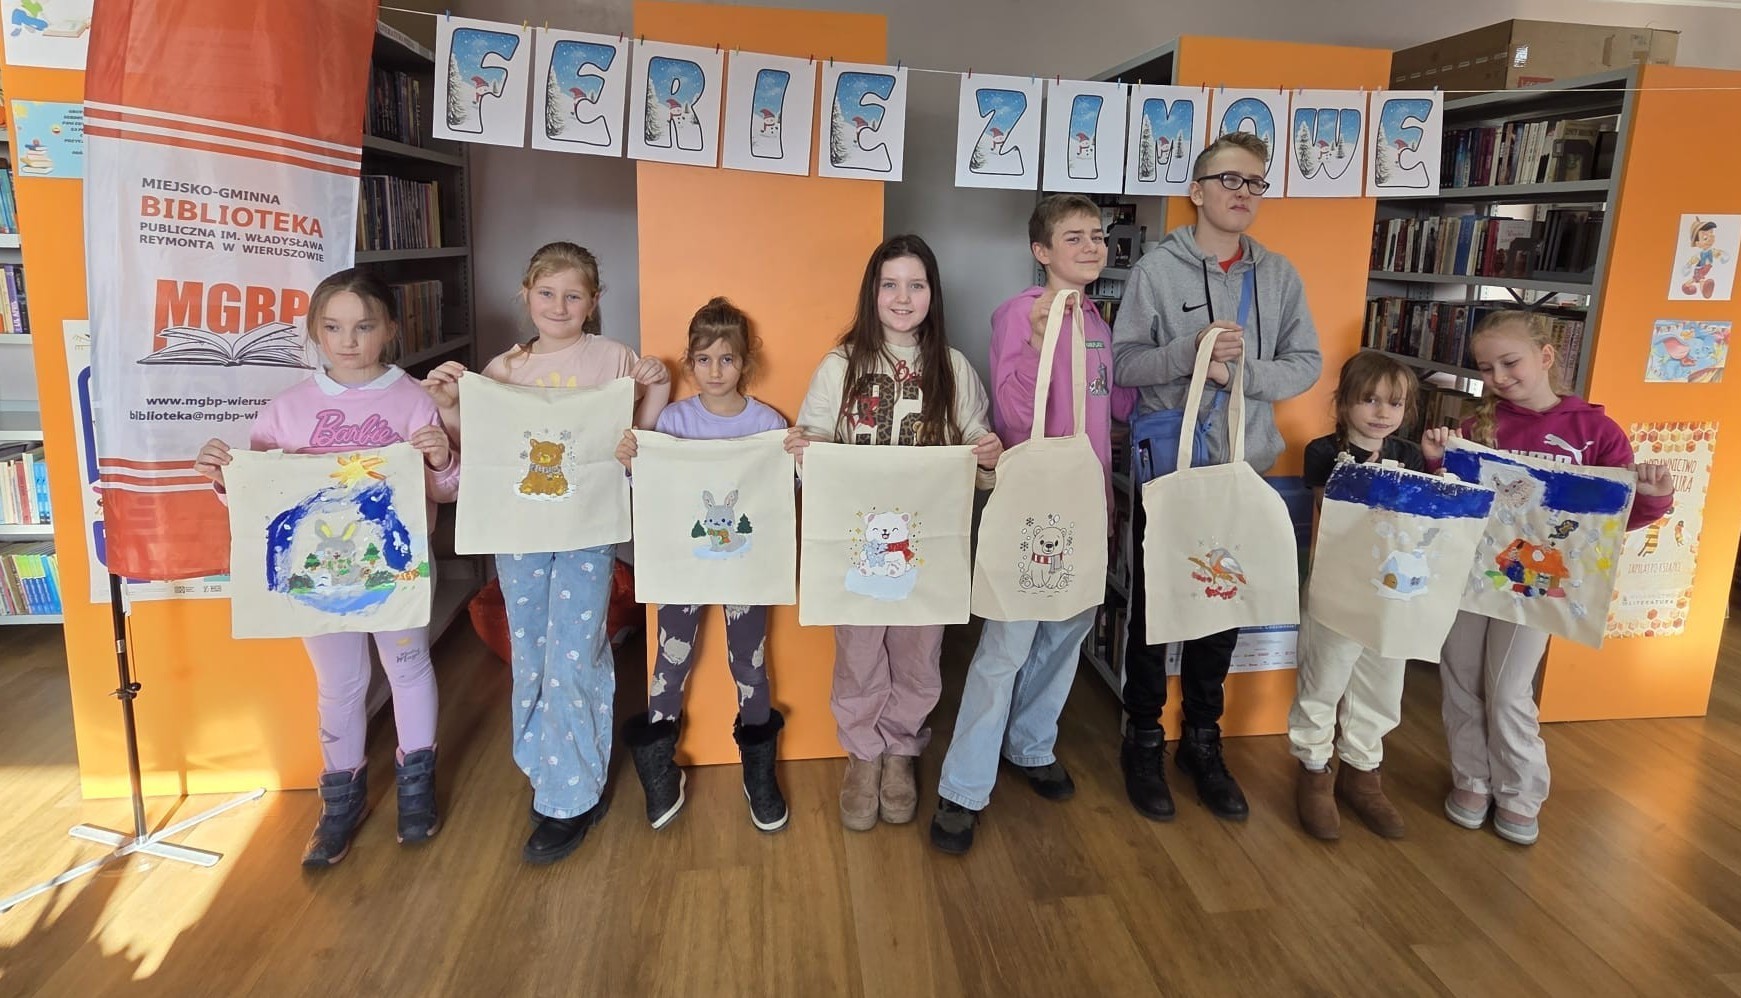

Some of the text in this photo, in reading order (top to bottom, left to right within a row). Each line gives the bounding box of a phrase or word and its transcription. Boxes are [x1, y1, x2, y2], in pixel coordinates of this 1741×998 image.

[446, 27, 1434, 188] FERIE ZIMOWE
[142, 177, 281, 205] MIEJSKO-GMINNA
[140, 195, 324, 238] BIBLIOTEKA
[139, 234, 325, 263] REYMONTA W WIERUSZOWIE
[140, 222, 324, 252] PUBLICZNA IM. WŁADYSŁAWA
[153, 279, 309, 352] MGBP
[129, 410, 258, 422] biblioteka@mgbp-wi
[146, 396, 271, 408] www.mgbp-wierus
[309, 409, 404, 447] Barbie
